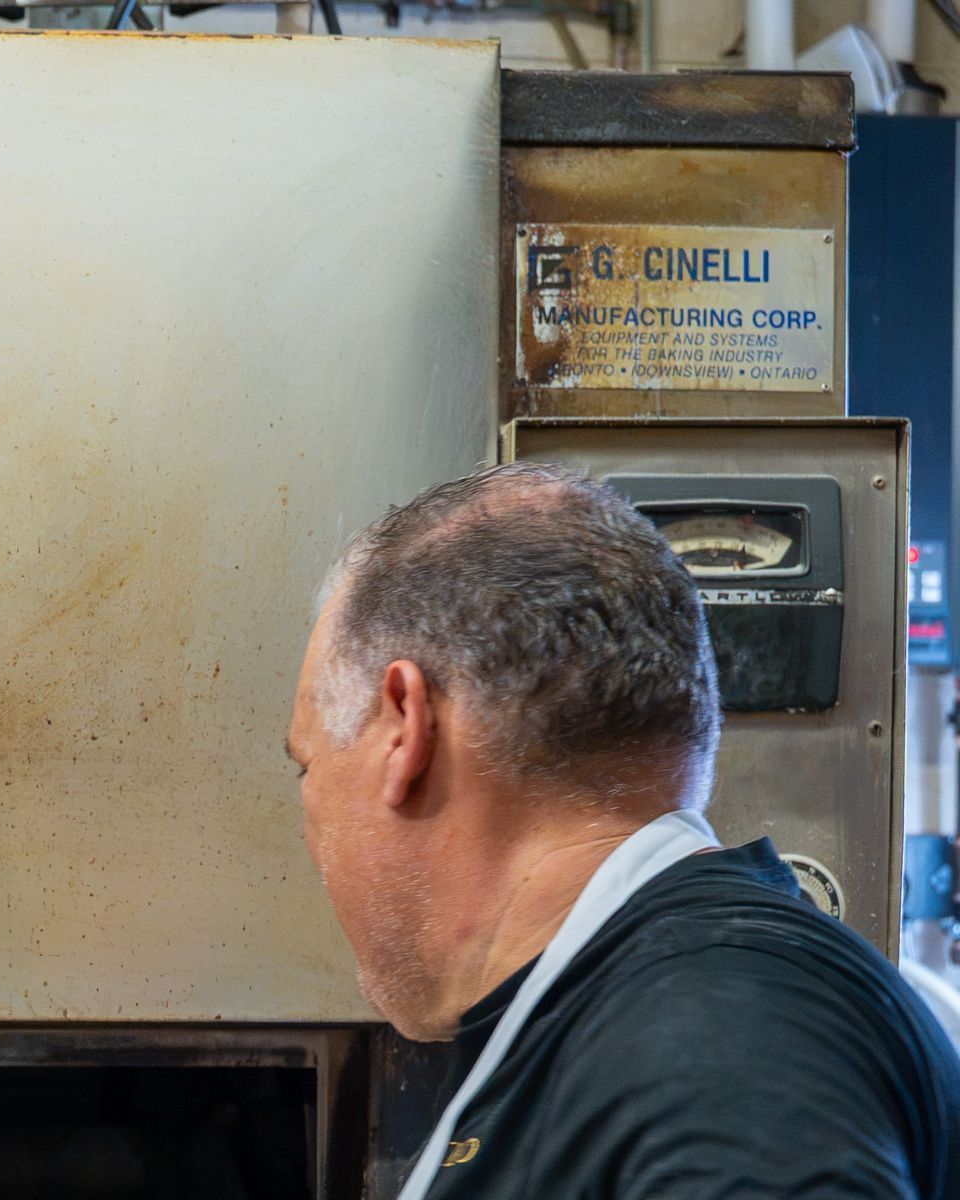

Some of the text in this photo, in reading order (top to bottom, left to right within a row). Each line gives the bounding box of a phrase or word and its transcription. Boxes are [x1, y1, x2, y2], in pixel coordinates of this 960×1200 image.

[644, 246, 769, 283] CINELLI
[539, 306, 822, 330] MANUFACTURING CORP.
[581, 331, 778, 347] EQUIPMENT AND SYSTEMS
[615, 347, 641, 360] THE
[647, 349, 704, 361] BAKING
[709, 350, 783, 363] INDUSTRY
[750, 366, 818, 381] ONTARIO
